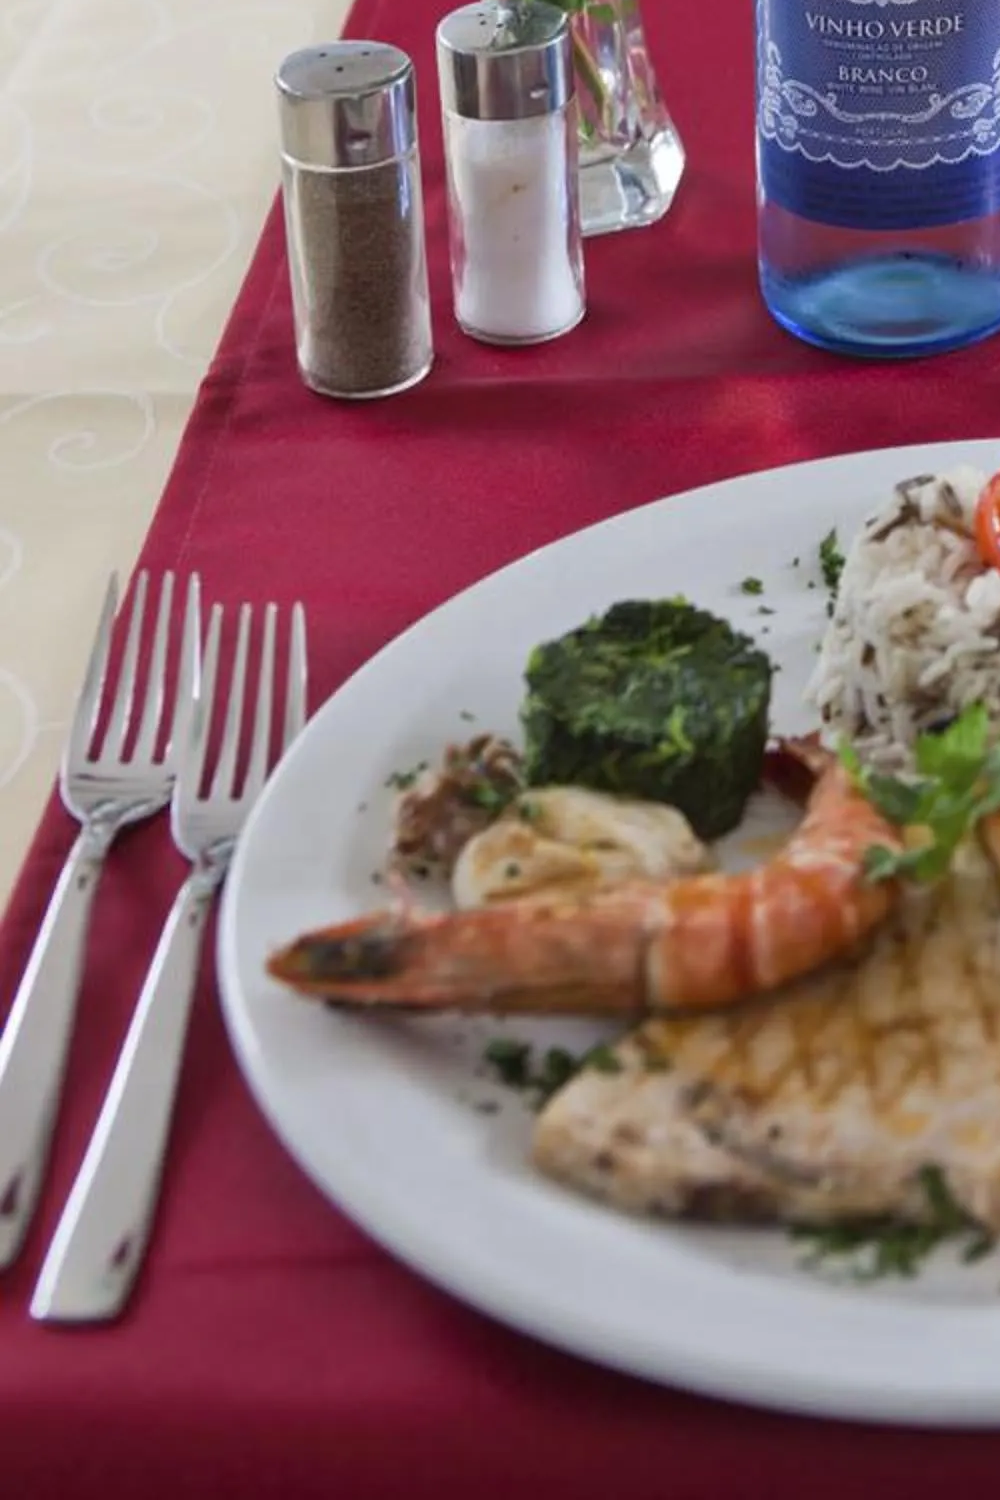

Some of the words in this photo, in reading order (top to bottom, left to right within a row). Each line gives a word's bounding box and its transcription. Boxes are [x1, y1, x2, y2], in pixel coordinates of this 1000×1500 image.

[805, 12, 885, 39] VINHO
[889, 13, 965, 37] VERDE
[838, 65, 928, 83] BRANCO
